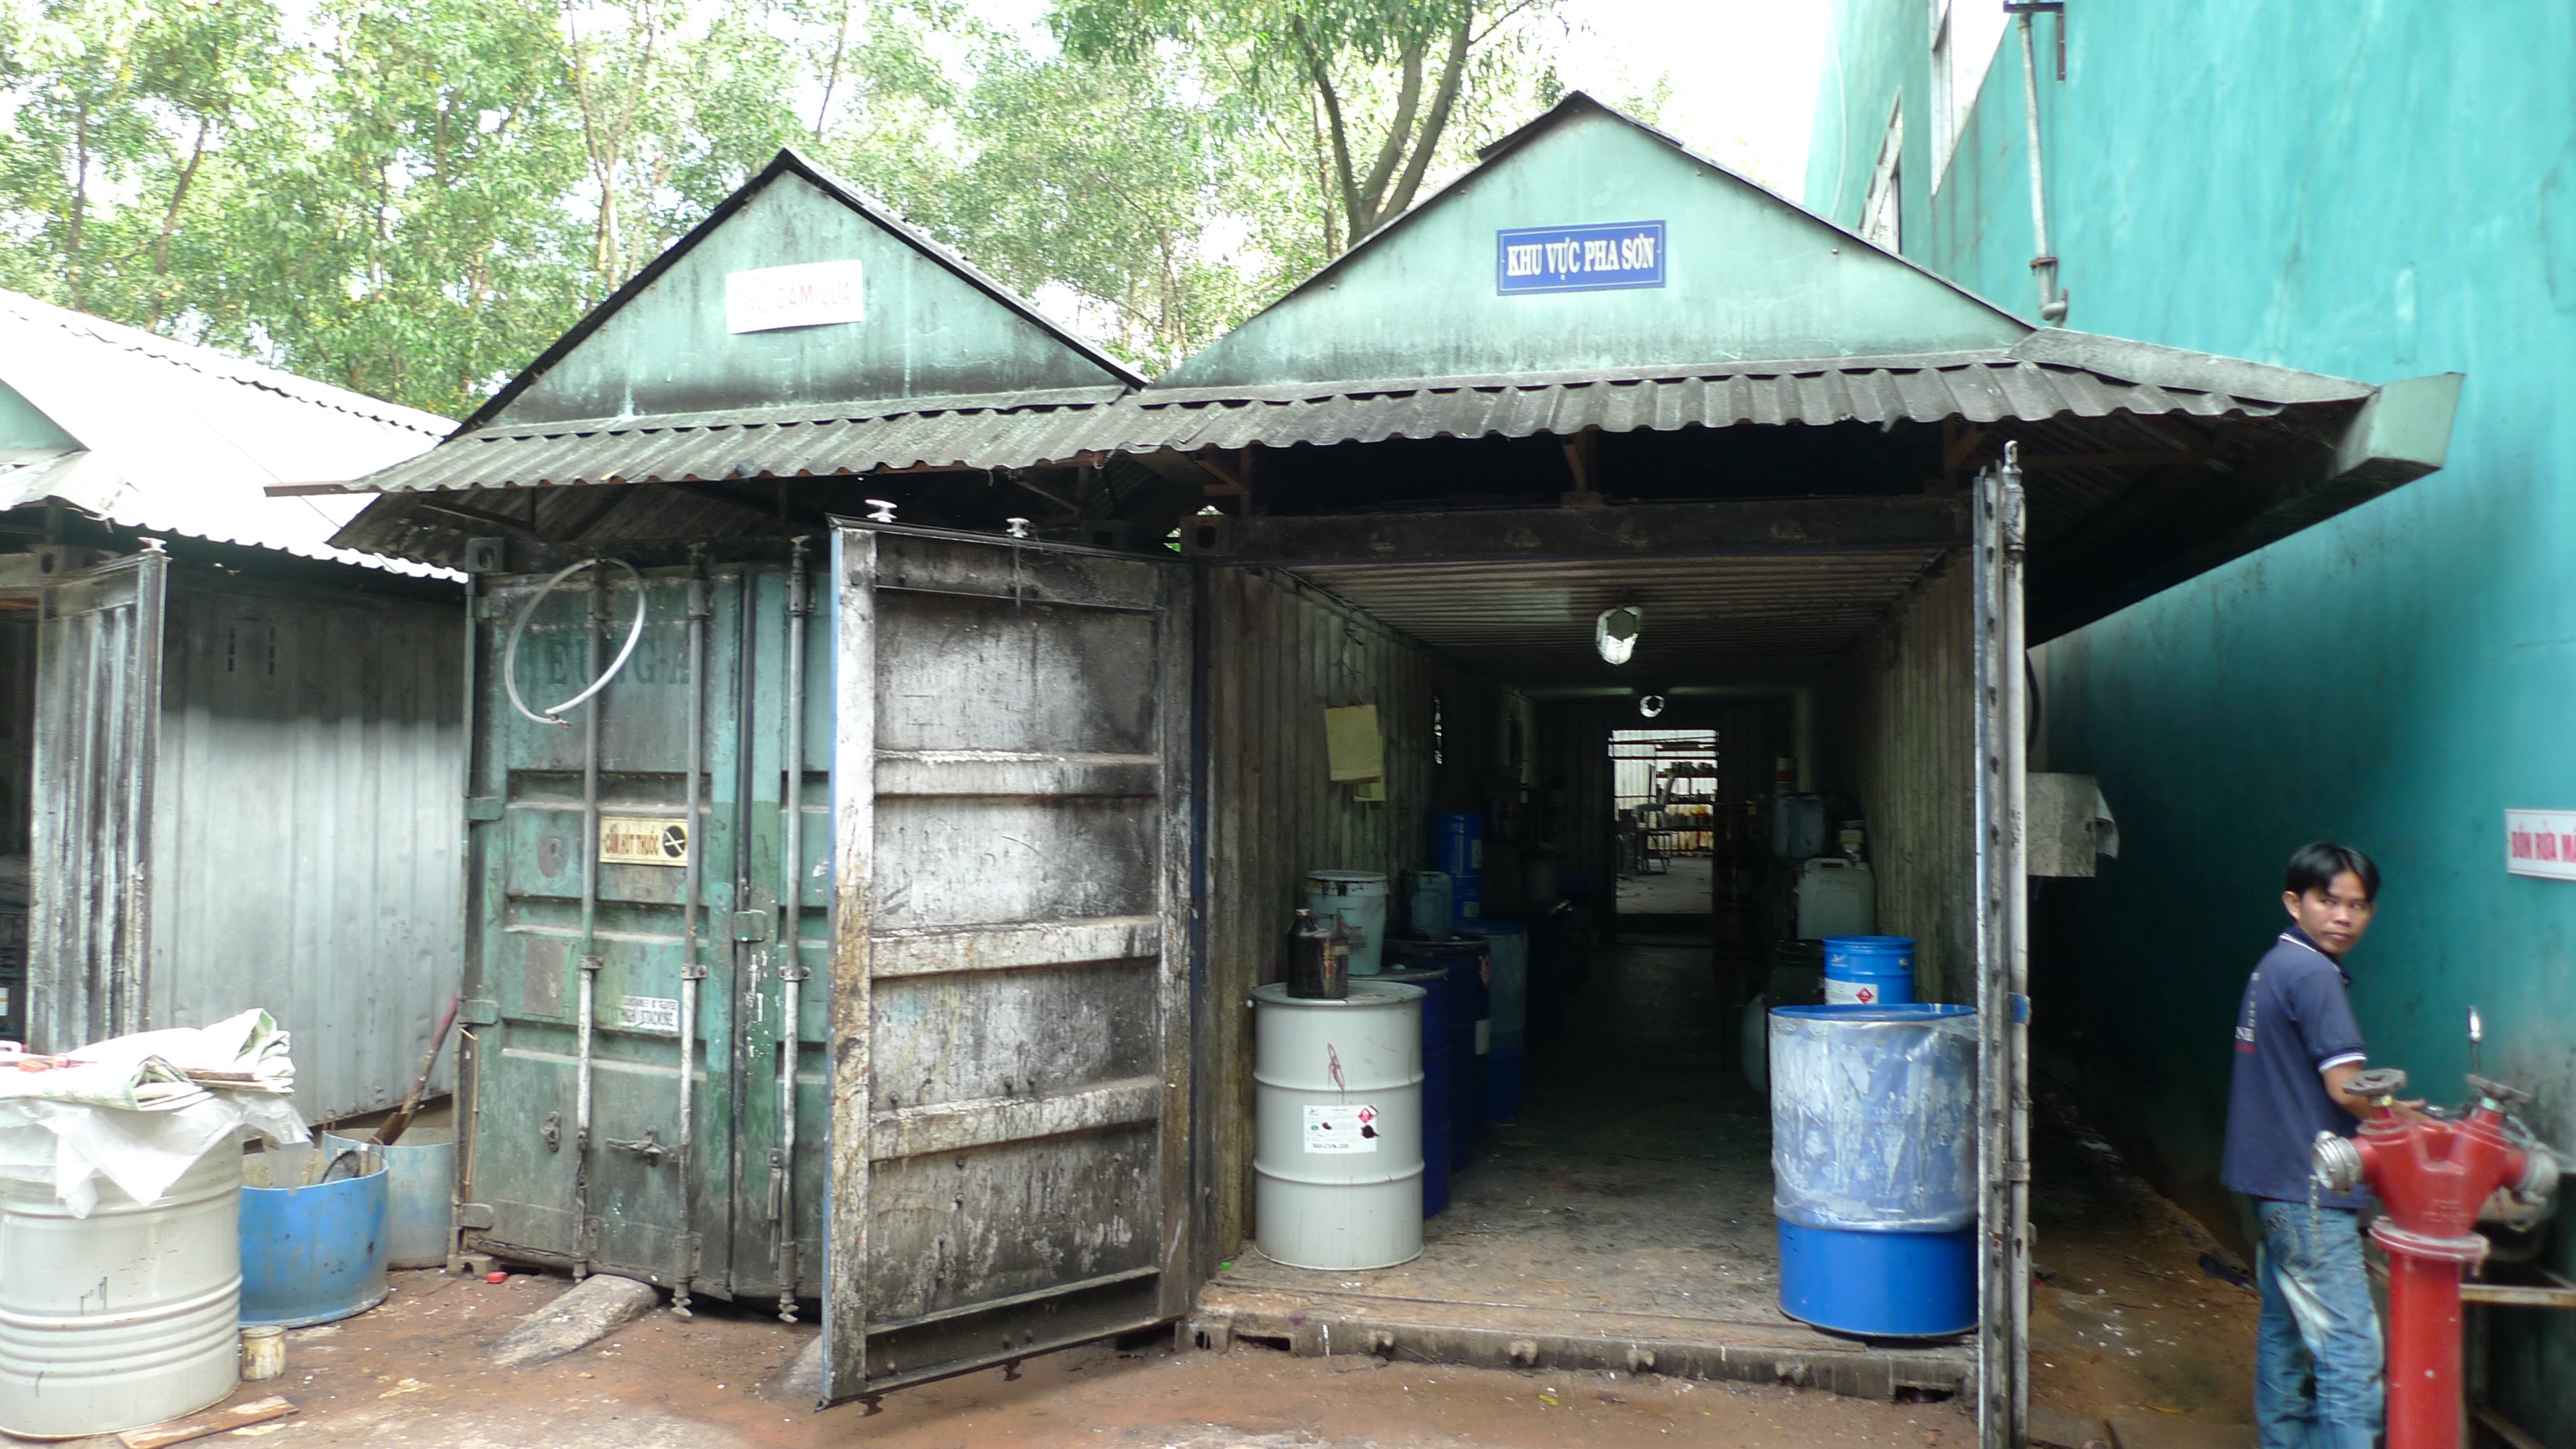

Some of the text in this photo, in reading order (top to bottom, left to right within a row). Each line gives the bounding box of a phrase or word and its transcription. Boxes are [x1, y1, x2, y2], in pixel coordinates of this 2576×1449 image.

[1507, 233, 1655, 280] KHU VỰC PHA SƠN
